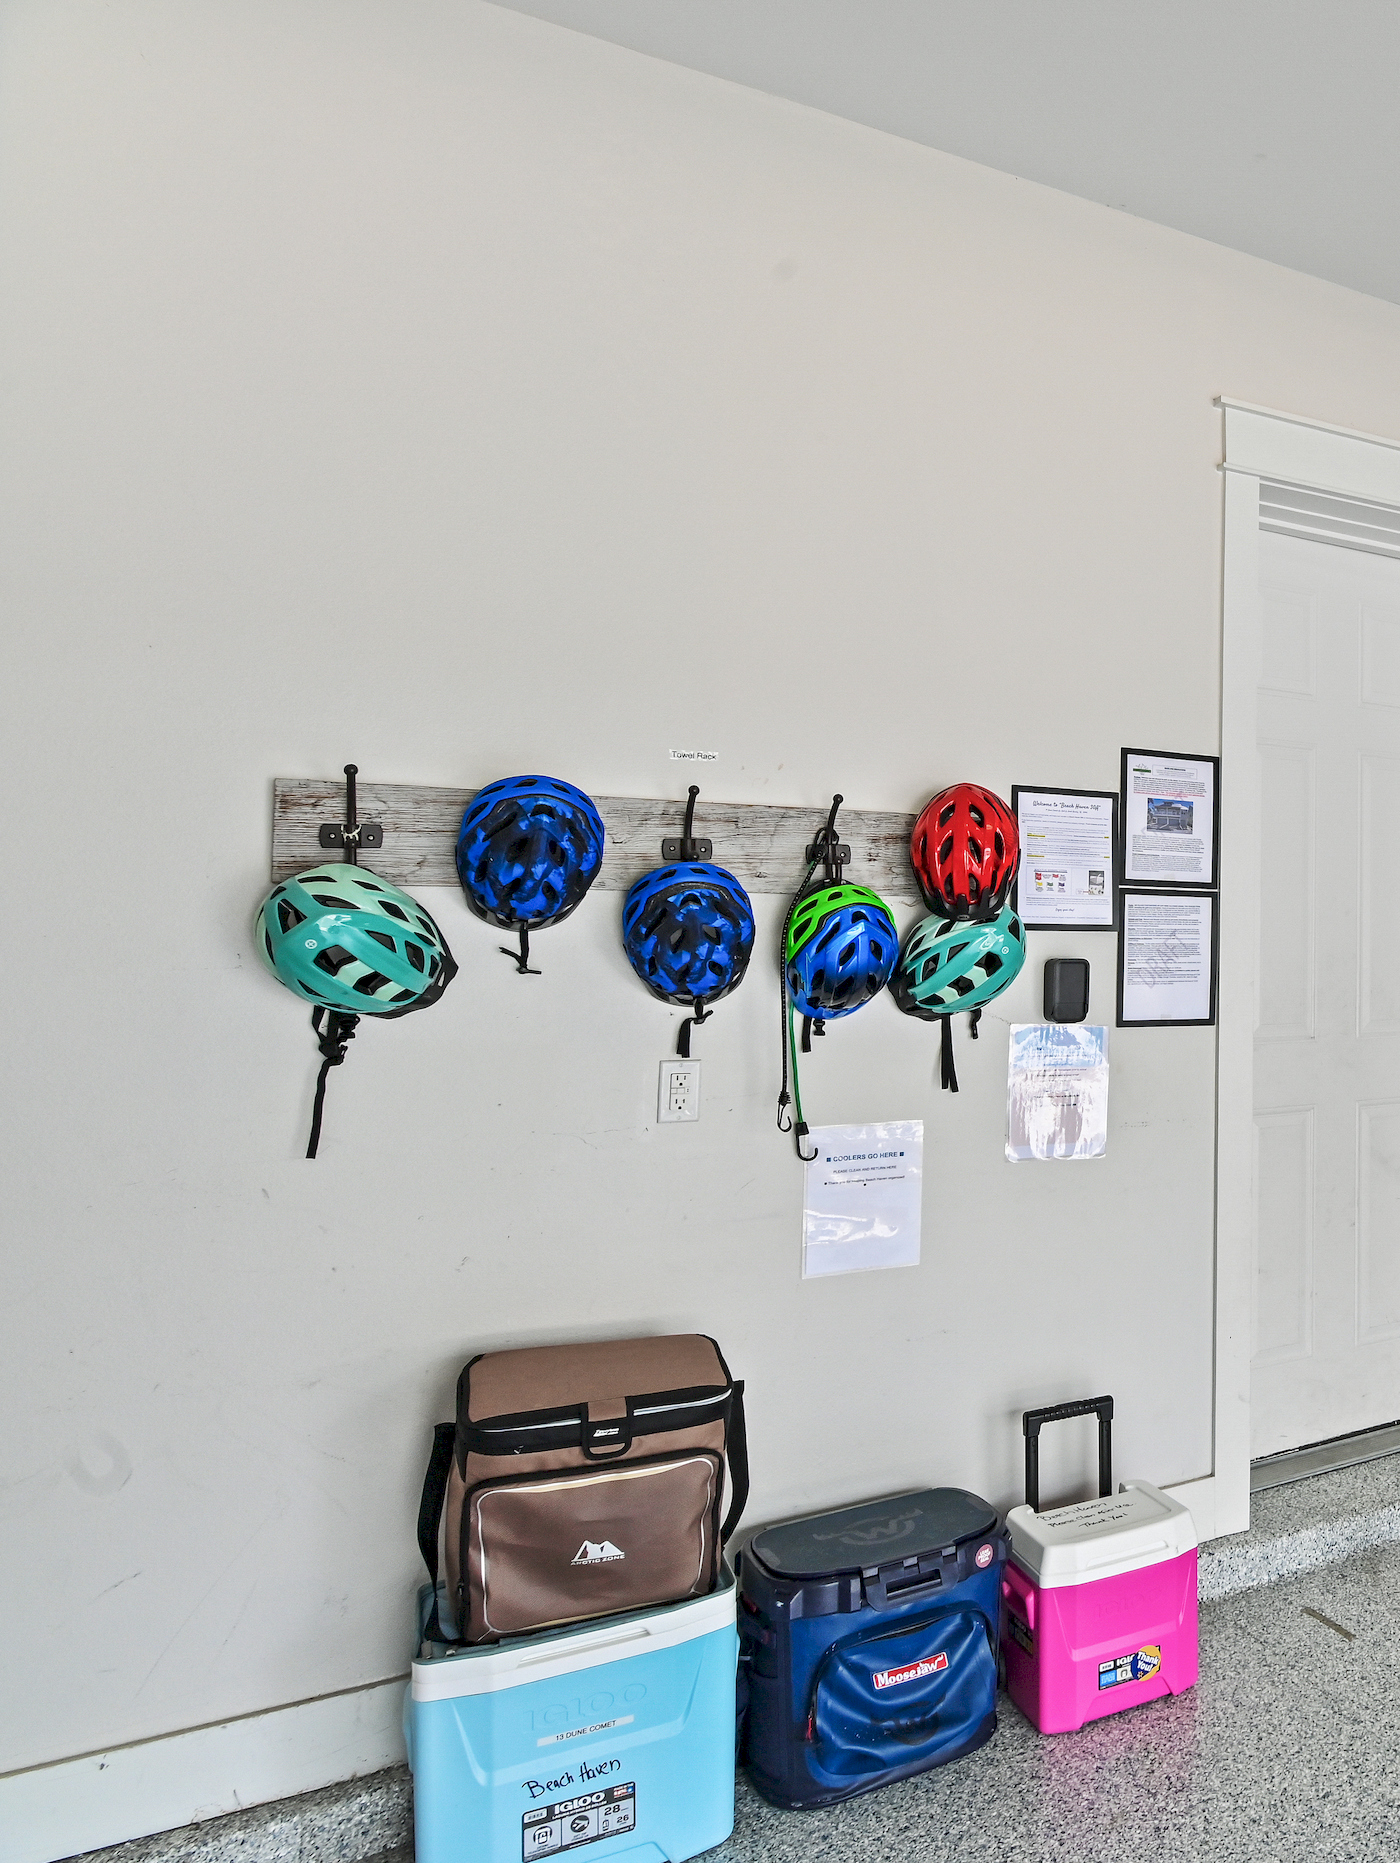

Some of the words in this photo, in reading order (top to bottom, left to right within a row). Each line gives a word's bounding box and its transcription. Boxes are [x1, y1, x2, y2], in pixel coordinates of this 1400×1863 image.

[1137, 1651, 1160, 1664] Thank
[1137, 1660, 1153, 1671] You!
[876, 1654, 943, 1687] Moosejaw
[566, 1728, 588, 1739] DUNE
[589, 1720, 617, 1732] COMET
[521, 1772, 574, 1799] Beach
[579, 1759, 621, 1782] Haven
[554, 1792, 606, 1814] IGLOO
[604, 1804, 621, 1816] 28
[616, 1814, 629, 1823] 26
